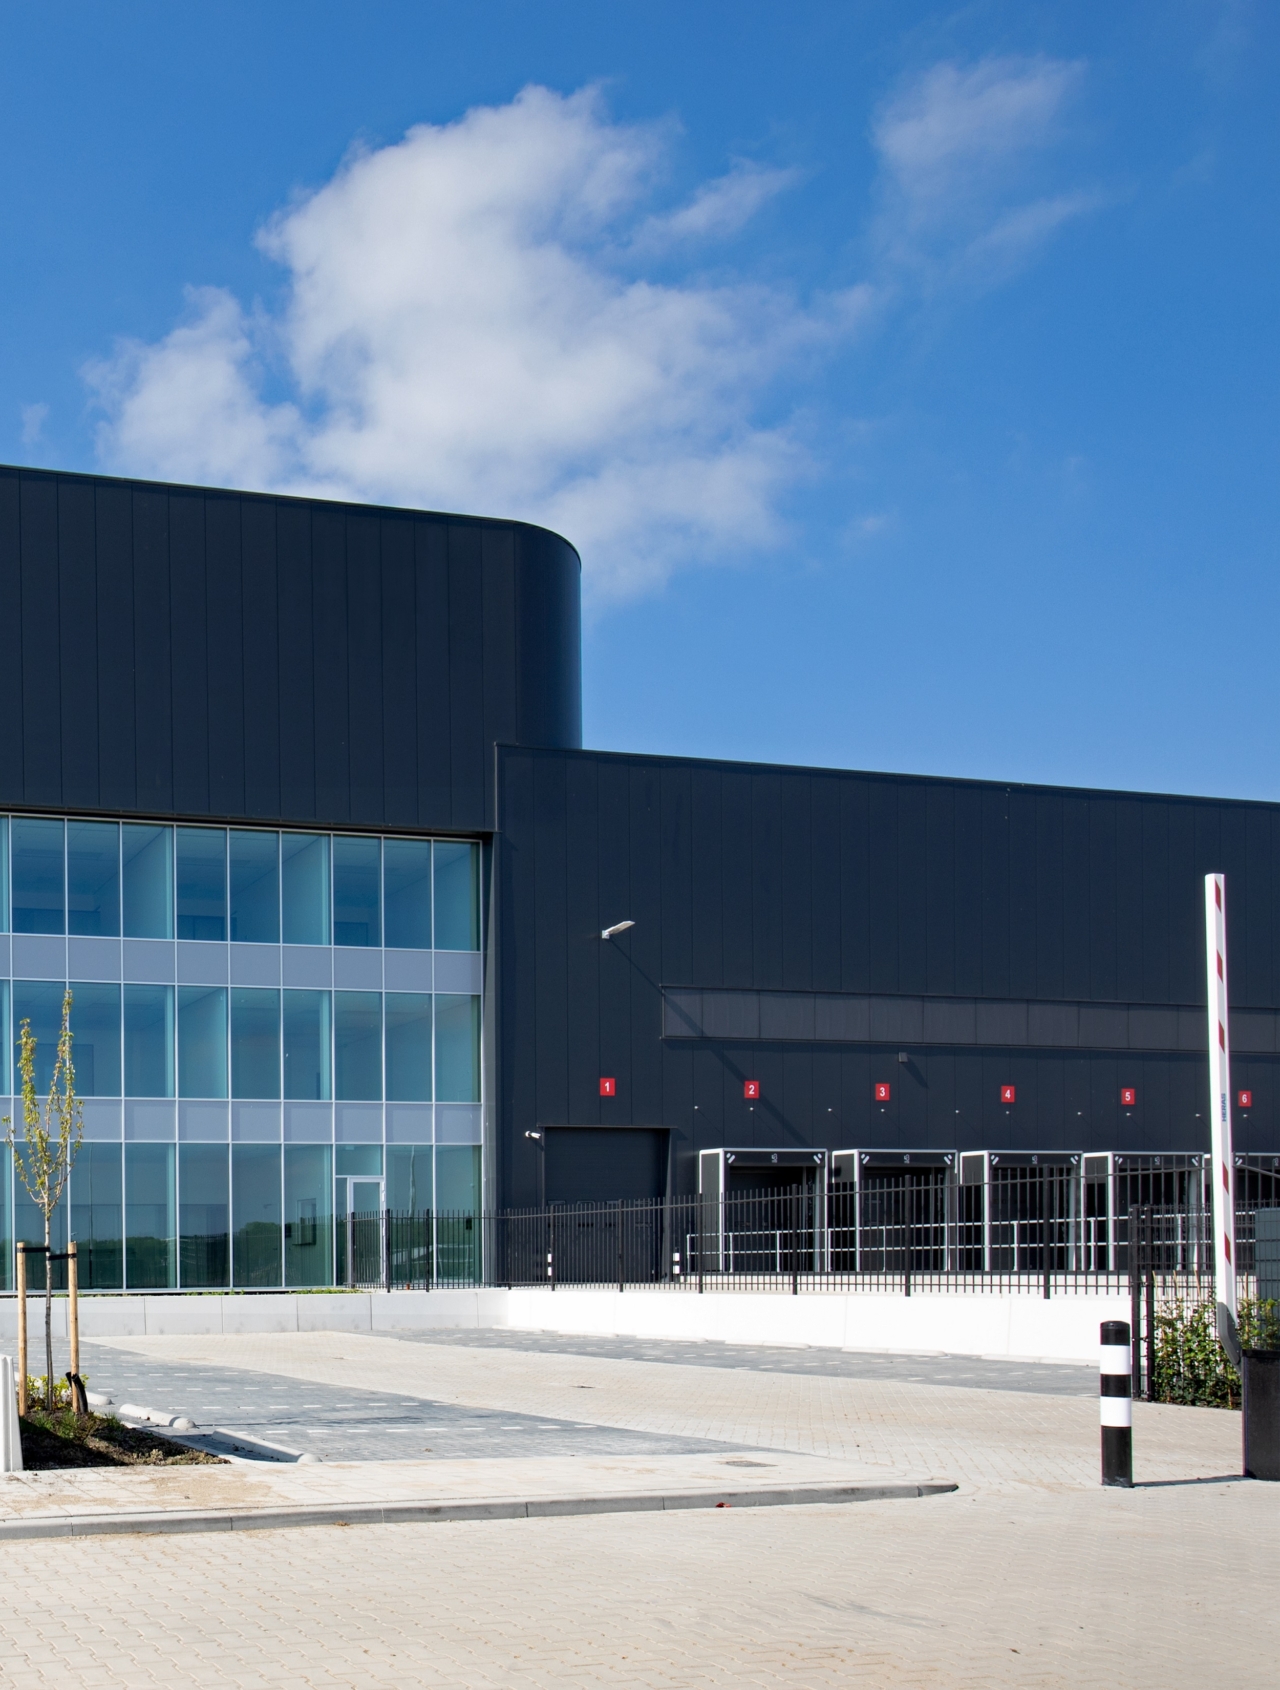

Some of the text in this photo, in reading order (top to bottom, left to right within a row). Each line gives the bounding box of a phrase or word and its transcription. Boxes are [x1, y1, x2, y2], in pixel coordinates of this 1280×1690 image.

[604, 1082, 610, 1092] 1
[749, 1085, 755, 1095] 2
[879, 1087, 886, 1097] 3
[1005, 1089, 1011, 1099] 4
[1125, 1092, 1131, 1101] 5
[1242, 1094, 1248, 1103] 6
